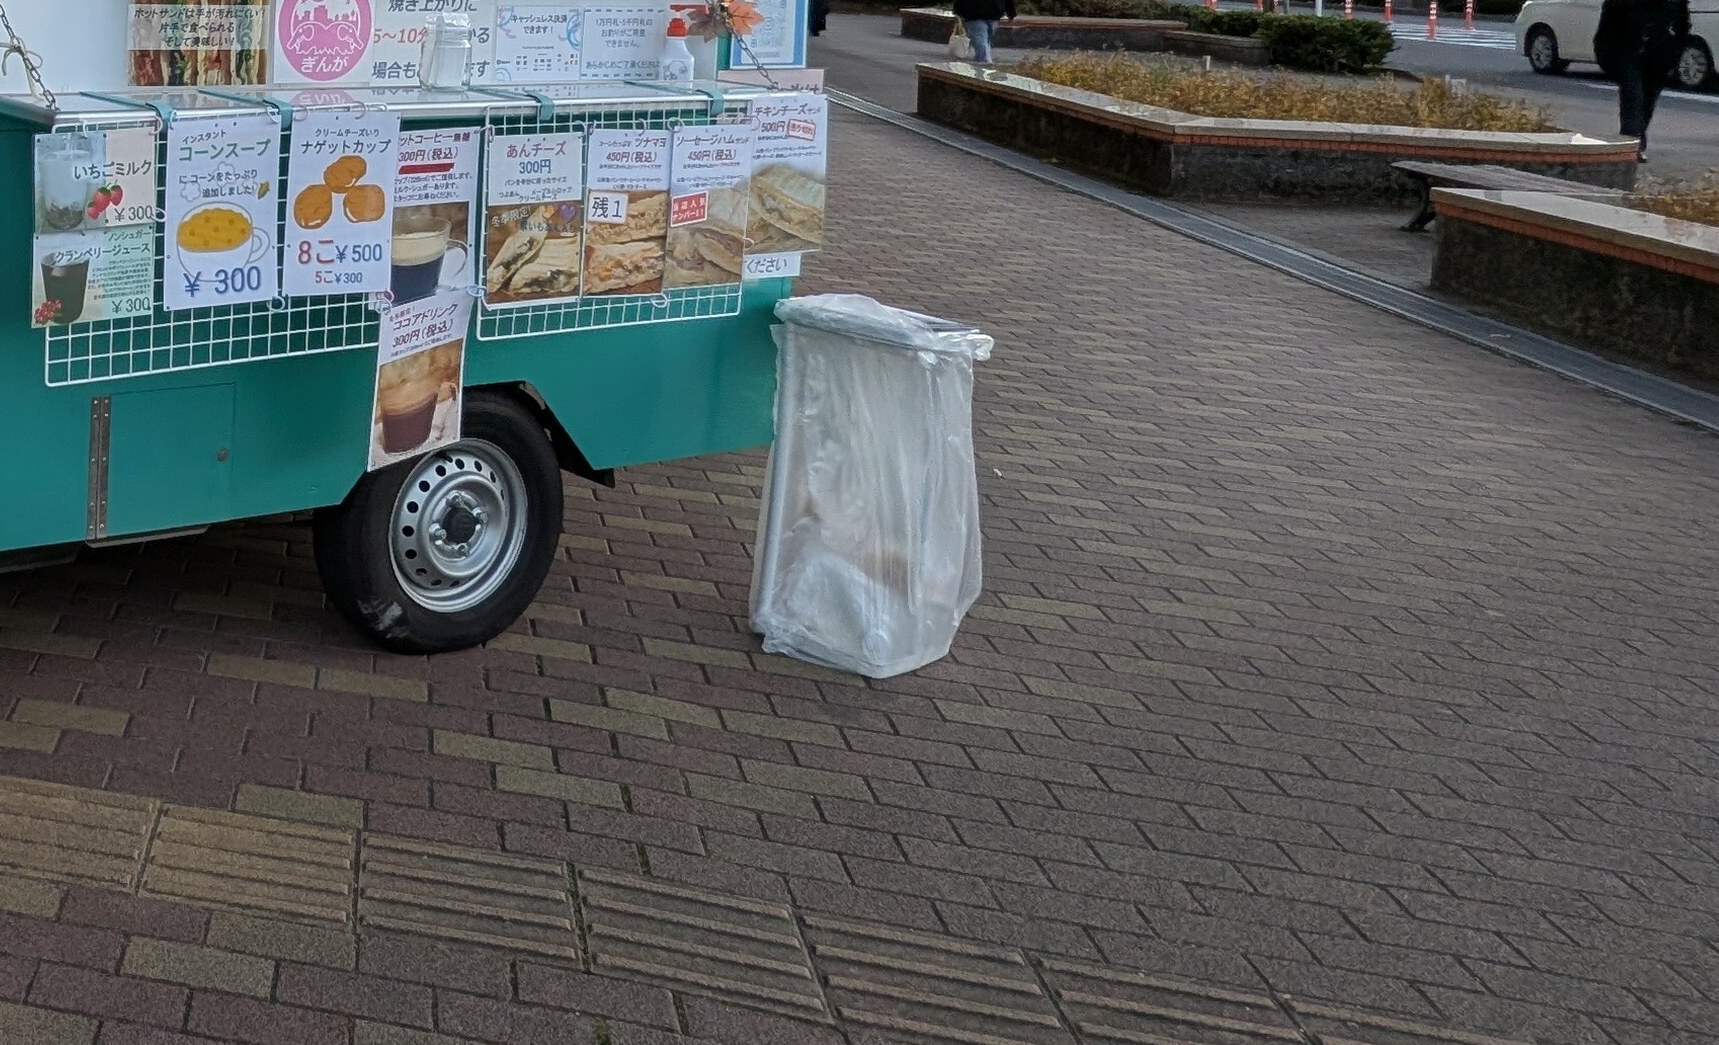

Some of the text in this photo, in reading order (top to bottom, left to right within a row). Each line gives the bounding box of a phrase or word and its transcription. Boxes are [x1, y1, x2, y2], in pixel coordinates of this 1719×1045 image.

[301, 56, 349, 74] ぎんが
[315, 128, 379, 137] クリームチーズいり
[761, 120, 785, 133] 500円
[182, 130, 226, 144] インスタント
[635, 137, 667, 148] ツナマヨ
[179, 138, 271, 162] コーンスープ
[301, 139, 391, 154] ナゲットカップ
[507, 141, 566, 158] あんチーズ
[74, 159, 152, 180] いちごミルク
[519, 159, 551, 174] 300円
[108, 230, 150, 241] ノンシュガー
[55, 242, 150, 262] クランベリージュース
[746, 257, 787, 274] ください
[393, 303, 458, 330] ココアドリンク
